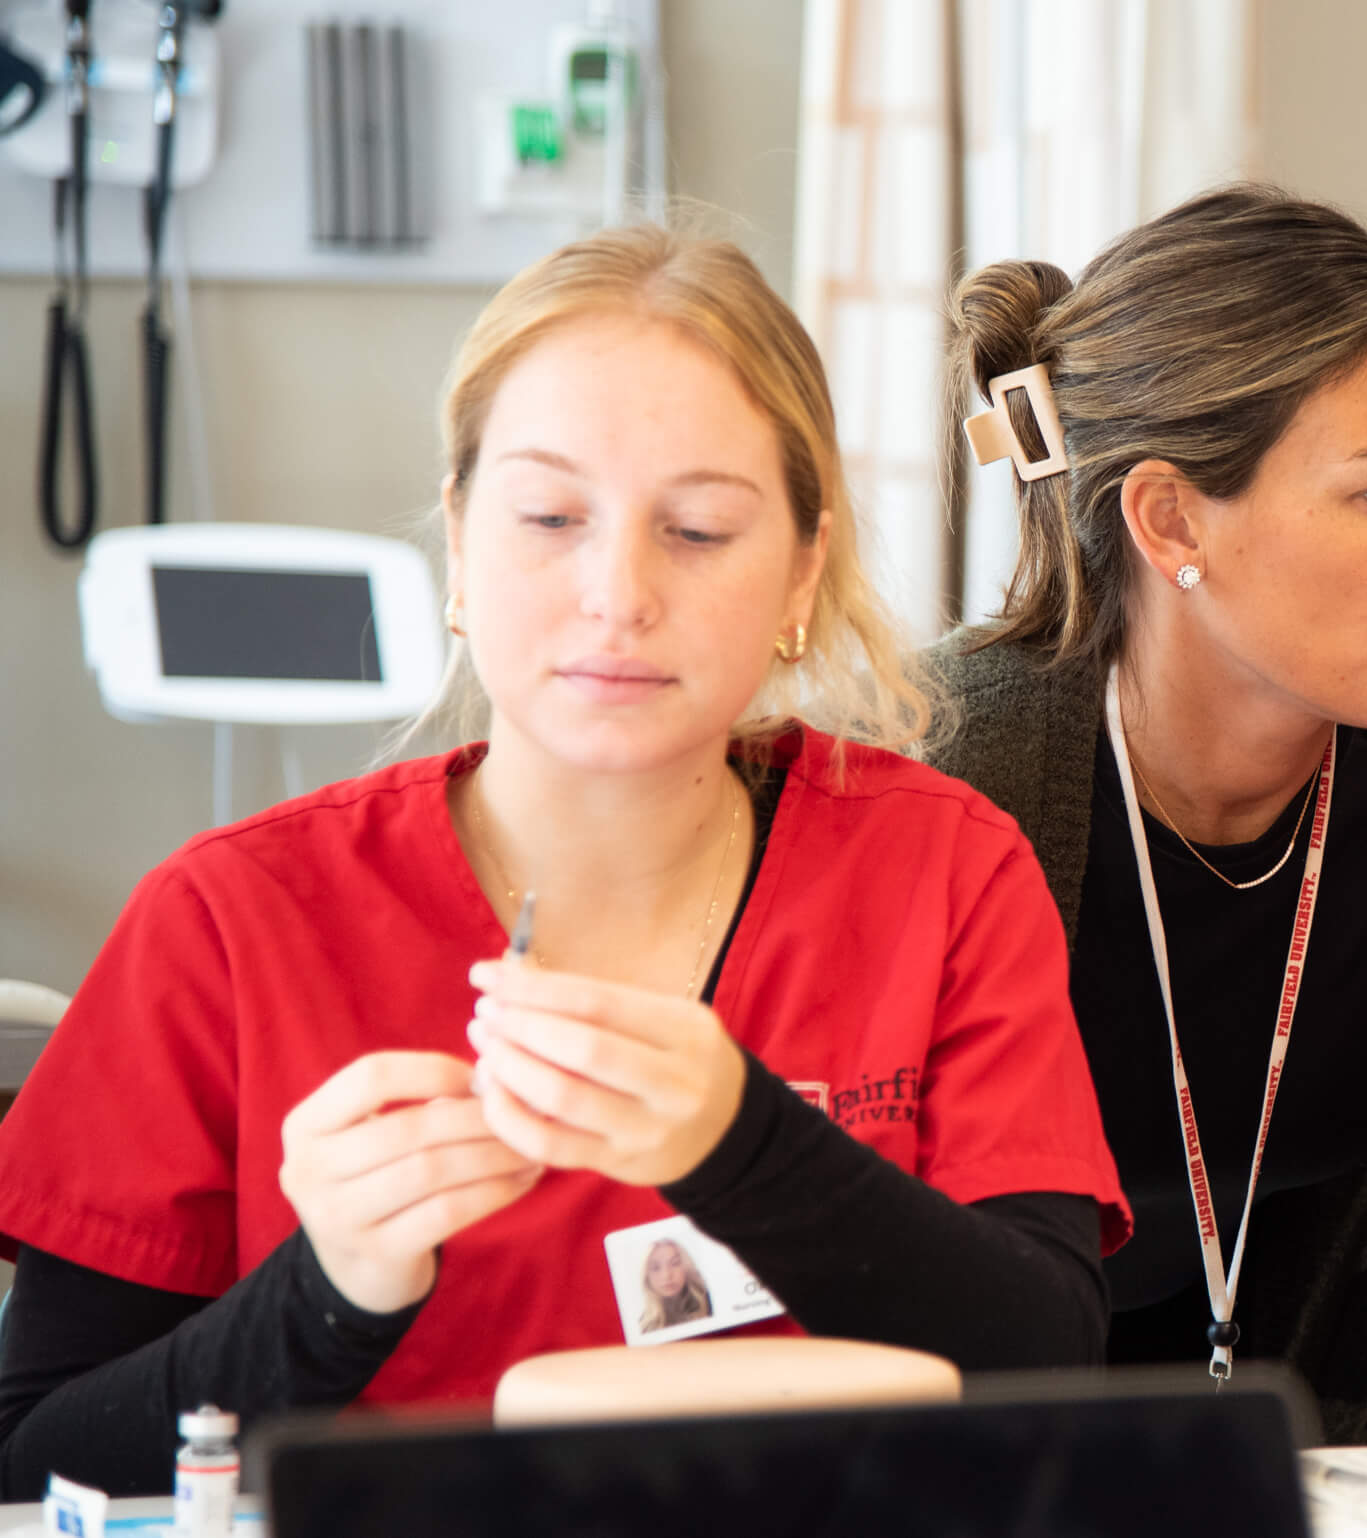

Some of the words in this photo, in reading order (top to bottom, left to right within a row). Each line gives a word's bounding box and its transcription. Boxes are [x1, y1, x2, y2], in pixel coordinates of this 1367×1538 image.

[1309, 777, 1330, 849] FAIRFIELD
[1277, 965, 1300, 1037] FAIRFIELD
[832, 1066, 918, 1121] Fairfi
[1179, 1086, 1200, 1157] FAIRFIELD
